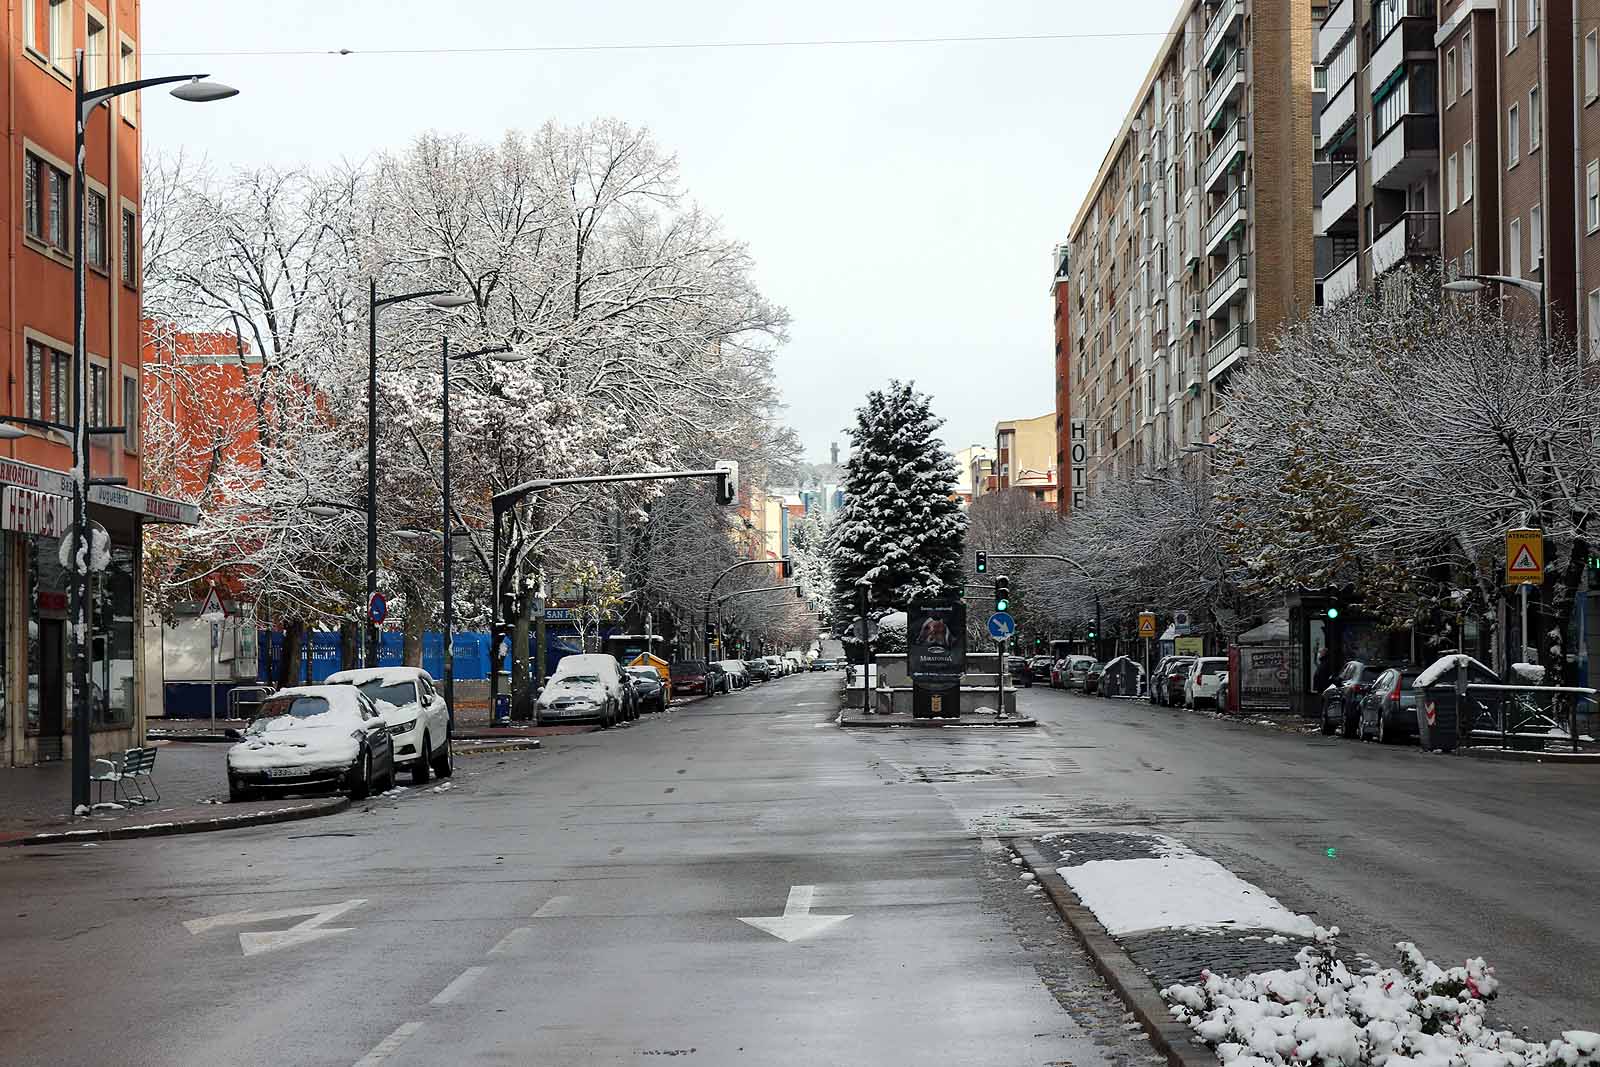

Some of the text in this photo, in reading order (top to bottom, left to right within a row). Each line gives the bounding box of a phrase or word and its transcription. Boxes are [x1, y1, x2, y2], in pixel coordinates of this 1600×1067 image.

[0, 462, 39, 487] RMOSILLA
[1071, 422, 1085, 510] HOTE
[546, 610, 563, 619] SAN
